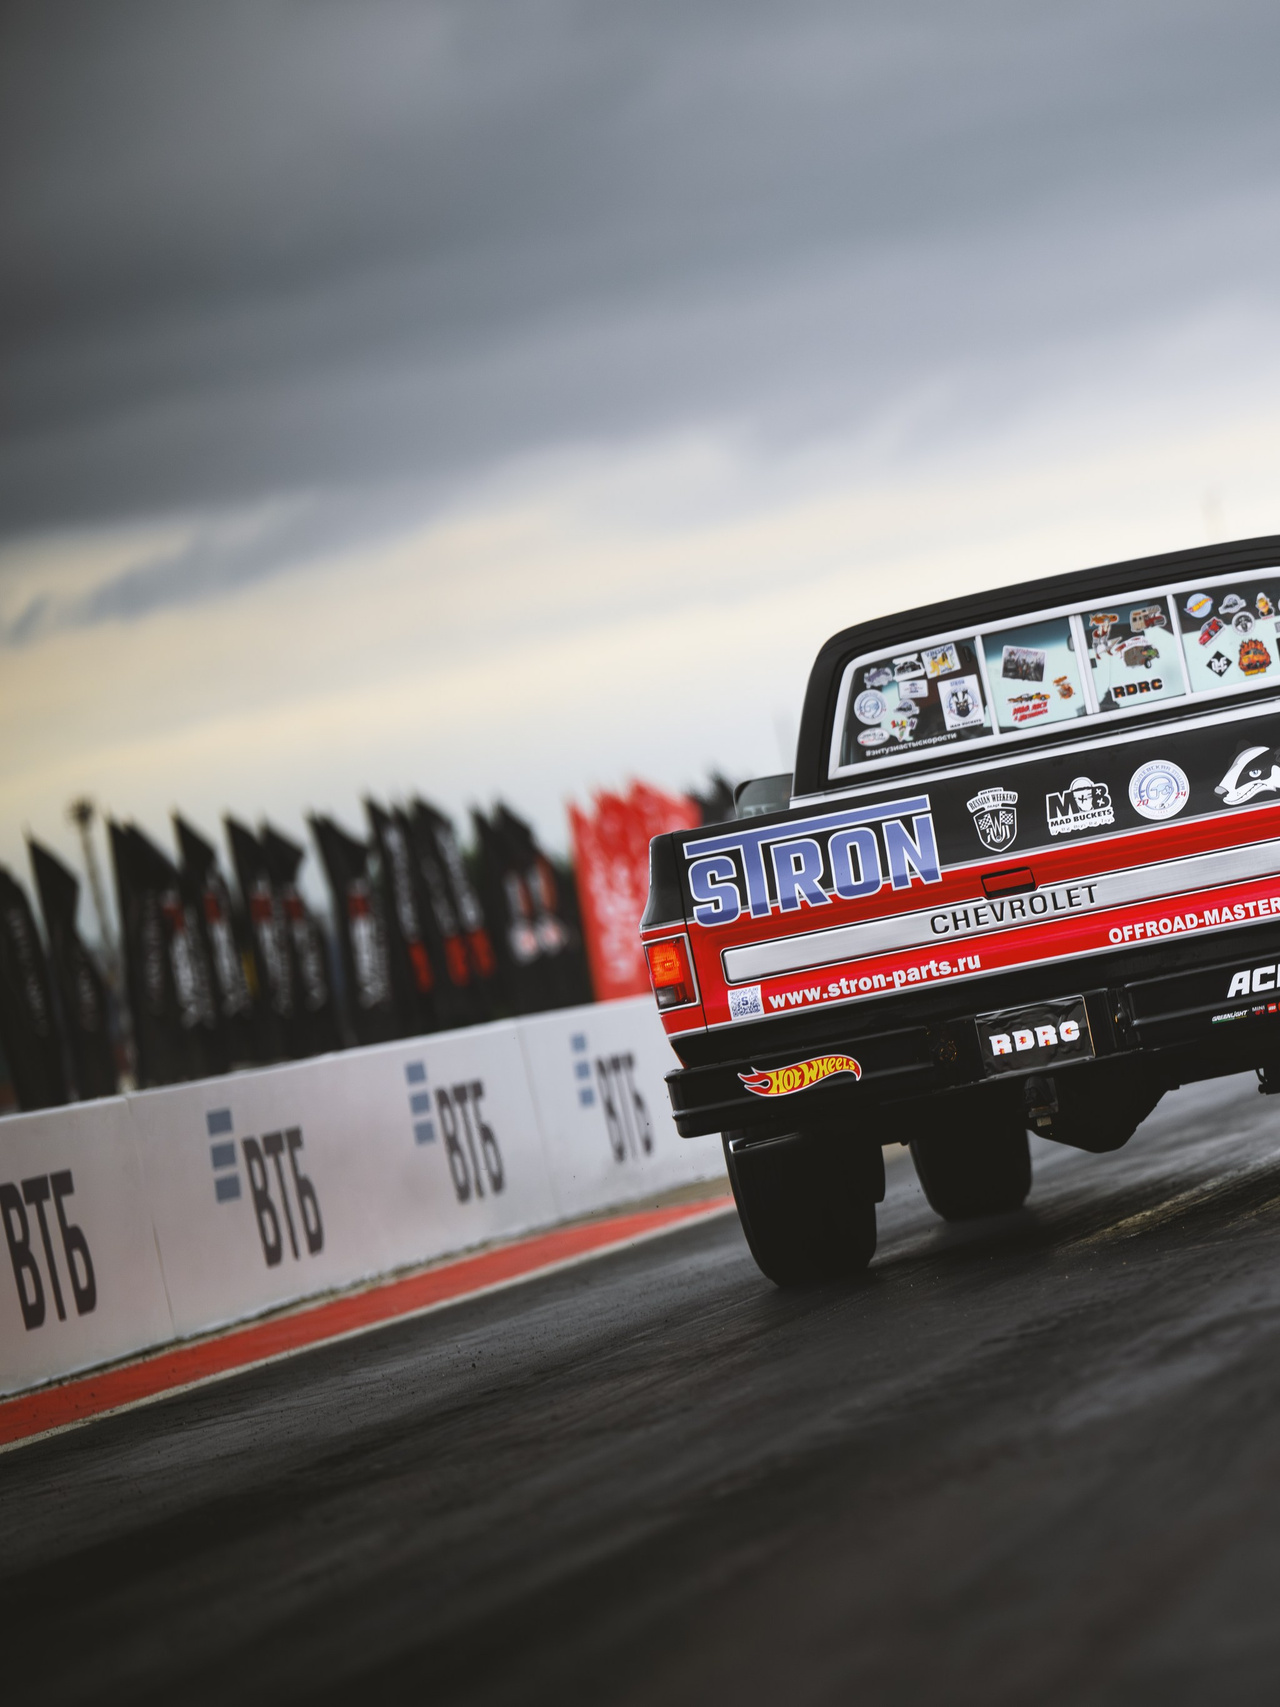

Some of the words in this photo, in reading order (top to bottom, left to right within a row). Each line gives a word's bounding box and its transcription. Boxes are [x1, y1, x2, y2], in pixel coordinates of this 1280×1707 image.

[1112, 678, 1163, 699] RDRC
[865, 733, 957, 757] #энтузиастыскорости
[1050, 818, 1071, 827] MAD
[1073, 809, 1112, 822] BUCKETS
[683, 794, 942, 927] STRON
[930, 883, 1099, 935] CHEVROLET
[768, 955, 981, 1009] www.stron-parts.ru
[989, 1020, 1080, 1056] RDRC
[768, 1064, 802, 1094] HOT
[595, 1053, 653, 1163] ВТБ
[434, 1080, 505, 1204] ВТБ
[241, 1126, 325, 1268] ВТБ
[0, 1169, 97, 1331] ВТБ
